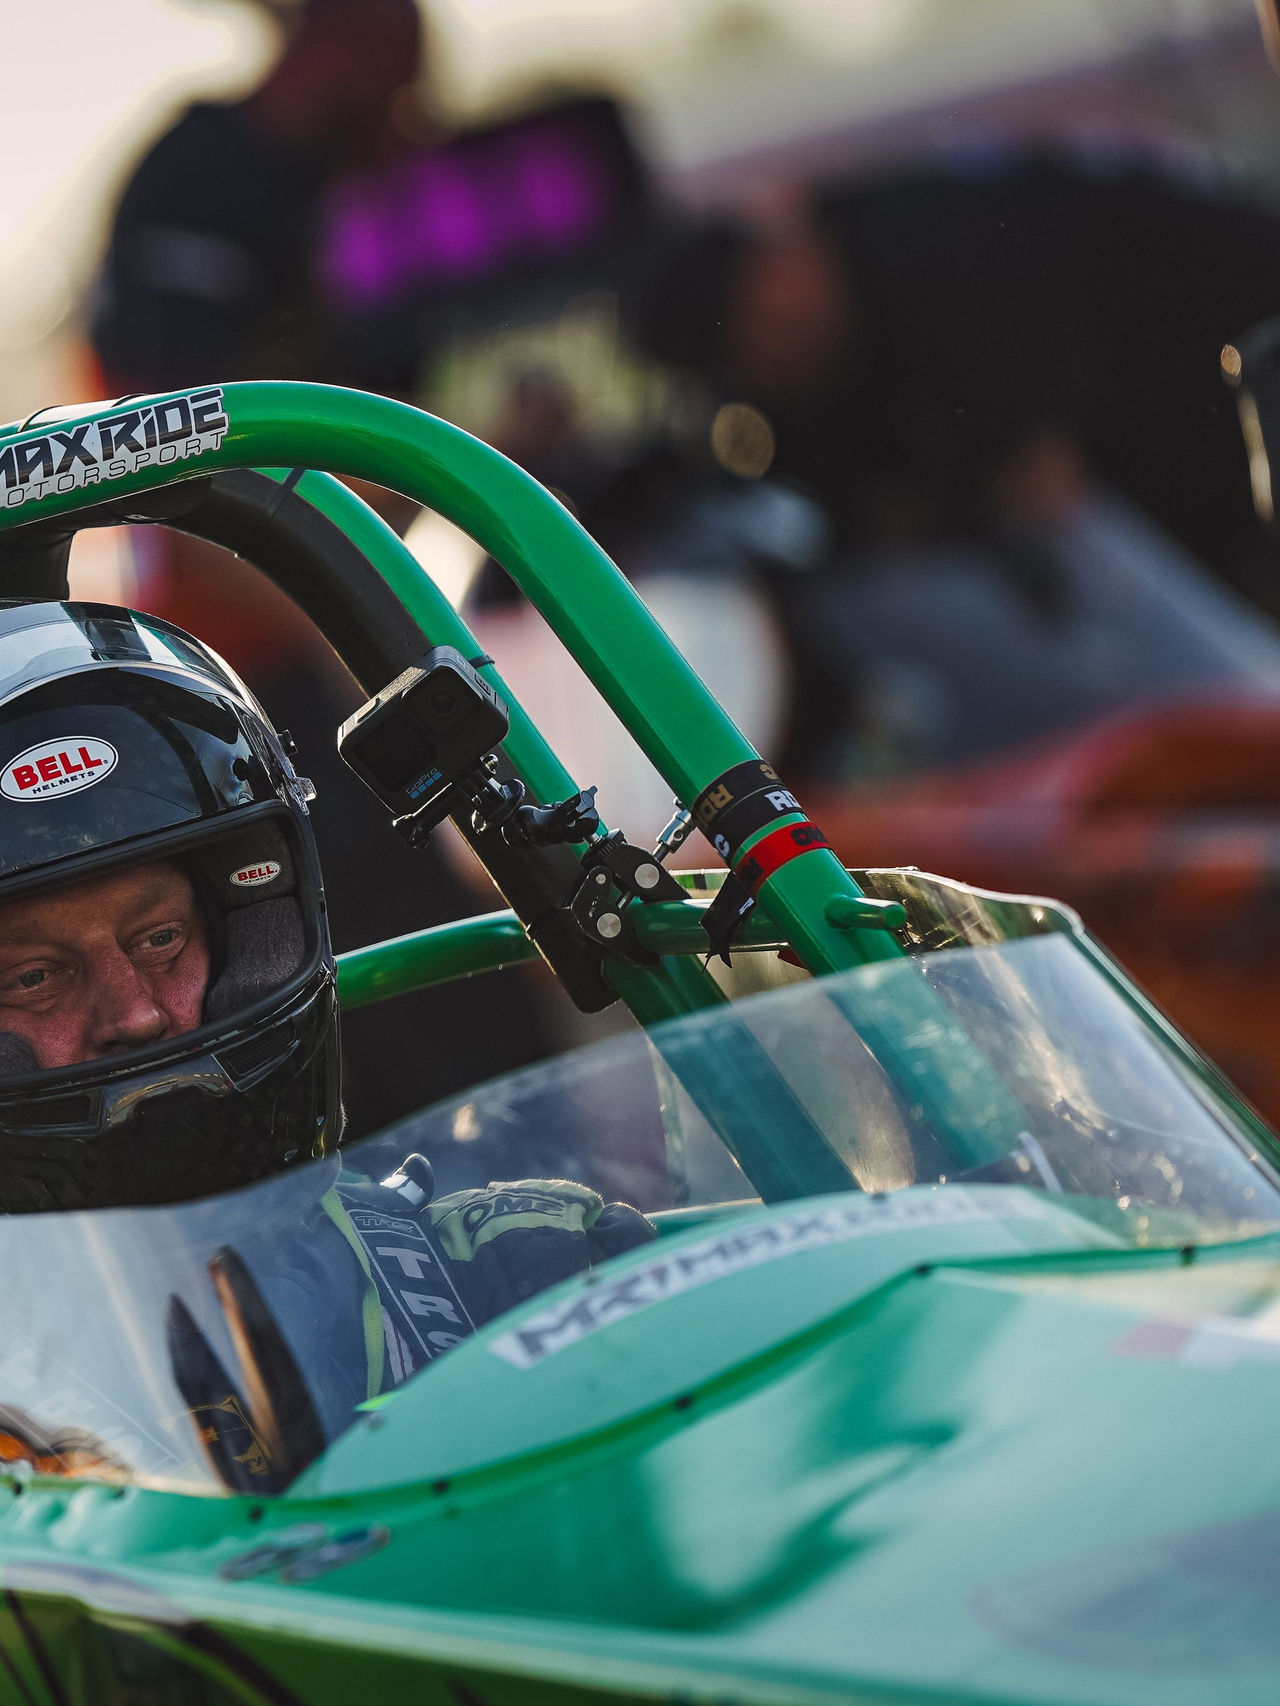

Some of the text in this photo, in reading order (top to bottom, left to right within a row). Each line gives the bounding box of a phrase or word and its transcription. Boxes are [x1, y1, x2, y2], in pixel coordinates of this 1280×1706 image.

[12, 746, 103, 791] BELL
[406, 767, 438, 794] GoPro
[32, 770, 95, 795] HELMETS
[237, 865, 274, 881] BELL
